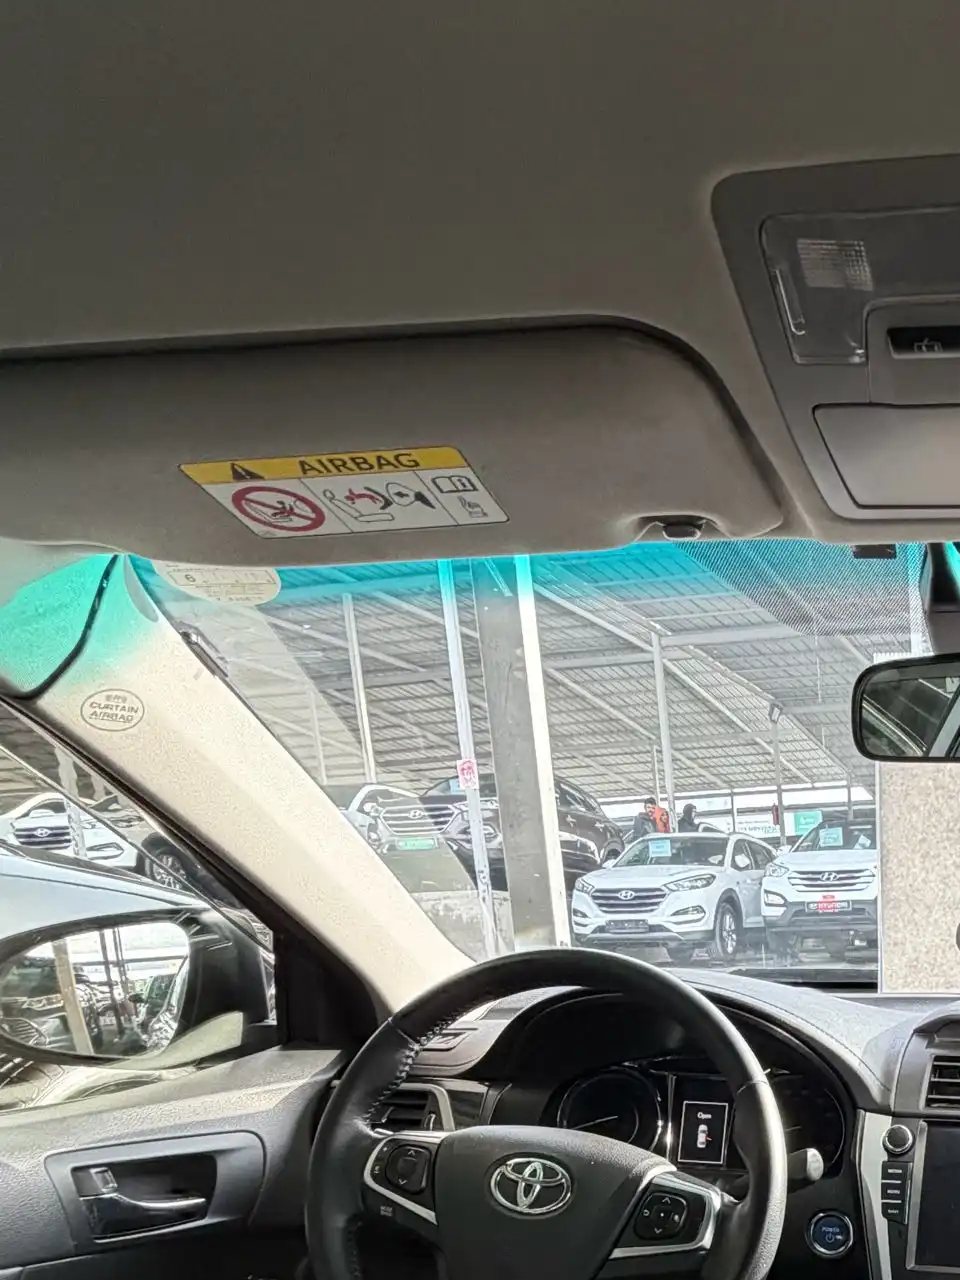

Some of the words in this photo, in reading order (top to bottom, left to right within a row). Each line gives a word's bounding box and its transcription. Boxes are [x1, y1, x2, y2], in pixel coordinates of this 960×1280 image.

[299, 452, 421, 477] AIRBAG
[89, 700, 140, 715] CURTAIN
[88, 710, 135, 723] AIRBAG
